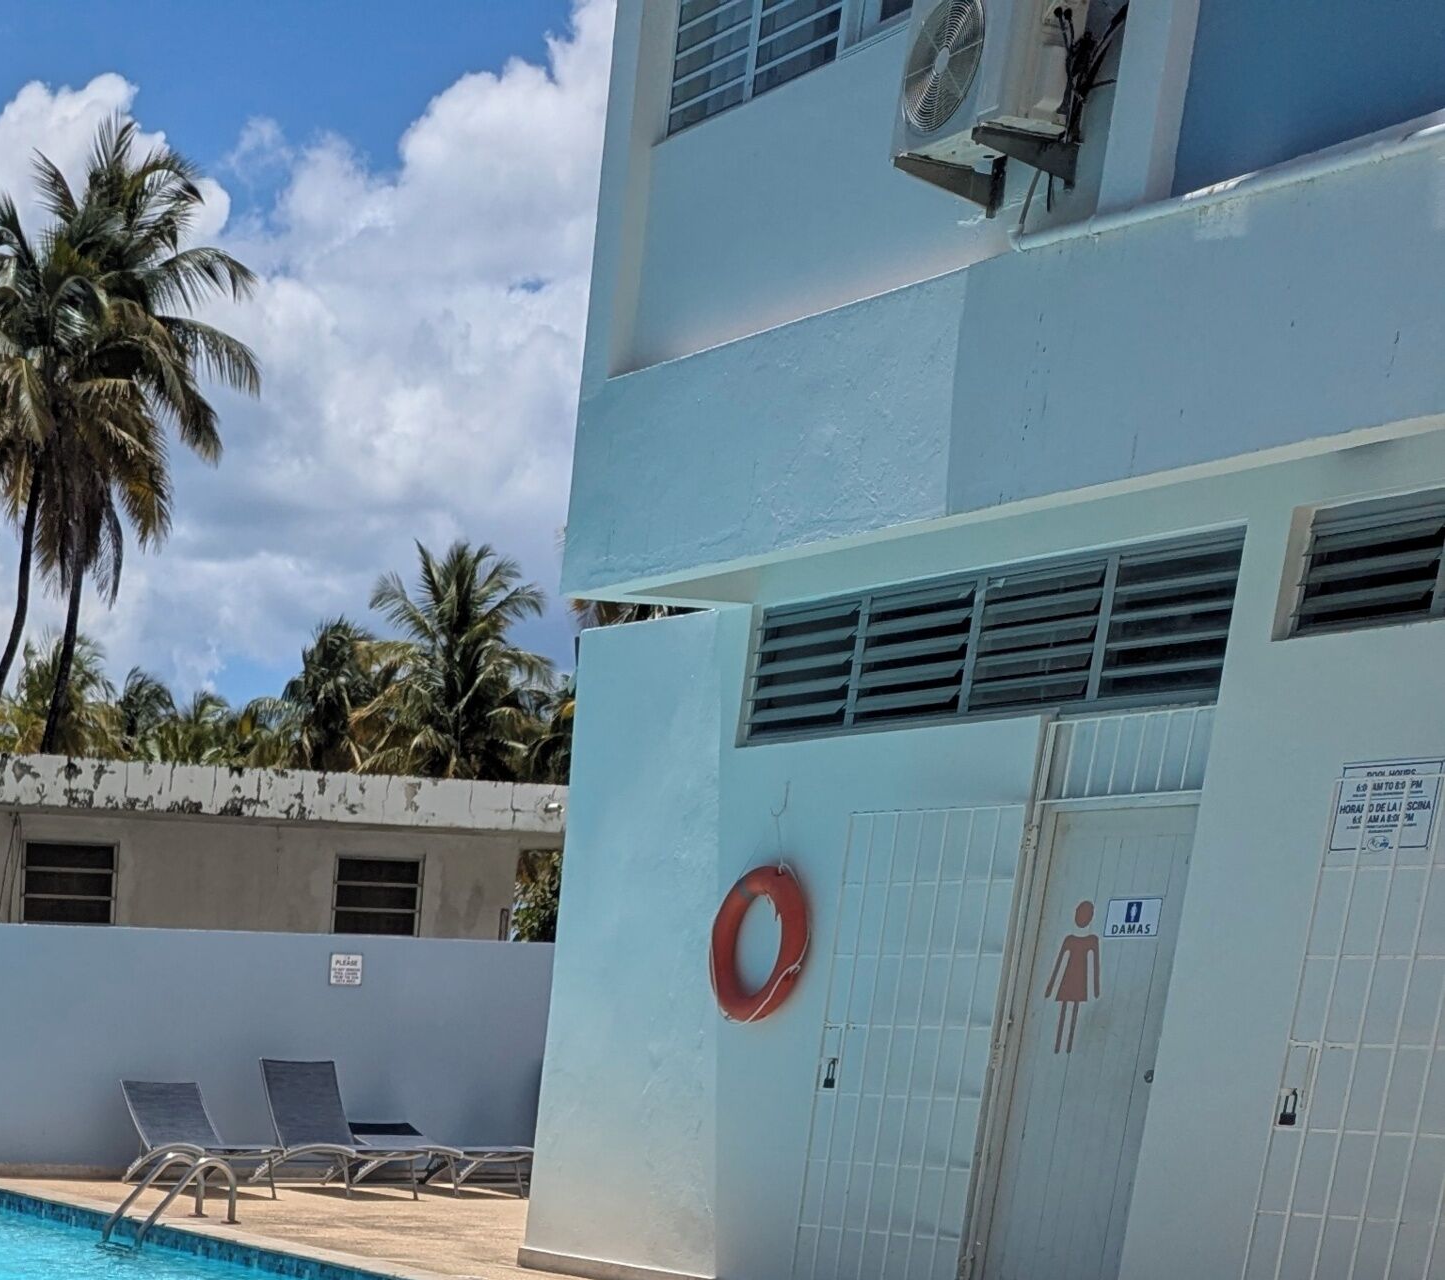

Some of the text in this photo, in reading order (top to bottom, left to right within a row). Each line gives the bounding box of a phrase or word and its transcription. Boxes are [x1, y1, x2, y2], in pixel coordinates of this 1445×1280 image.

[1356, 780, 1423, 792] 6:0 AM TO 8:0 PM
[1339, 800, 1431, 814] HORAO DE LA SCINA
[1352, 815, 1364, 824] 6:0
[1368, 814, 1380, 823] AM
[1380, 814, 1386, 823] A
[1111, 924, 1151, 934] DAMAS
